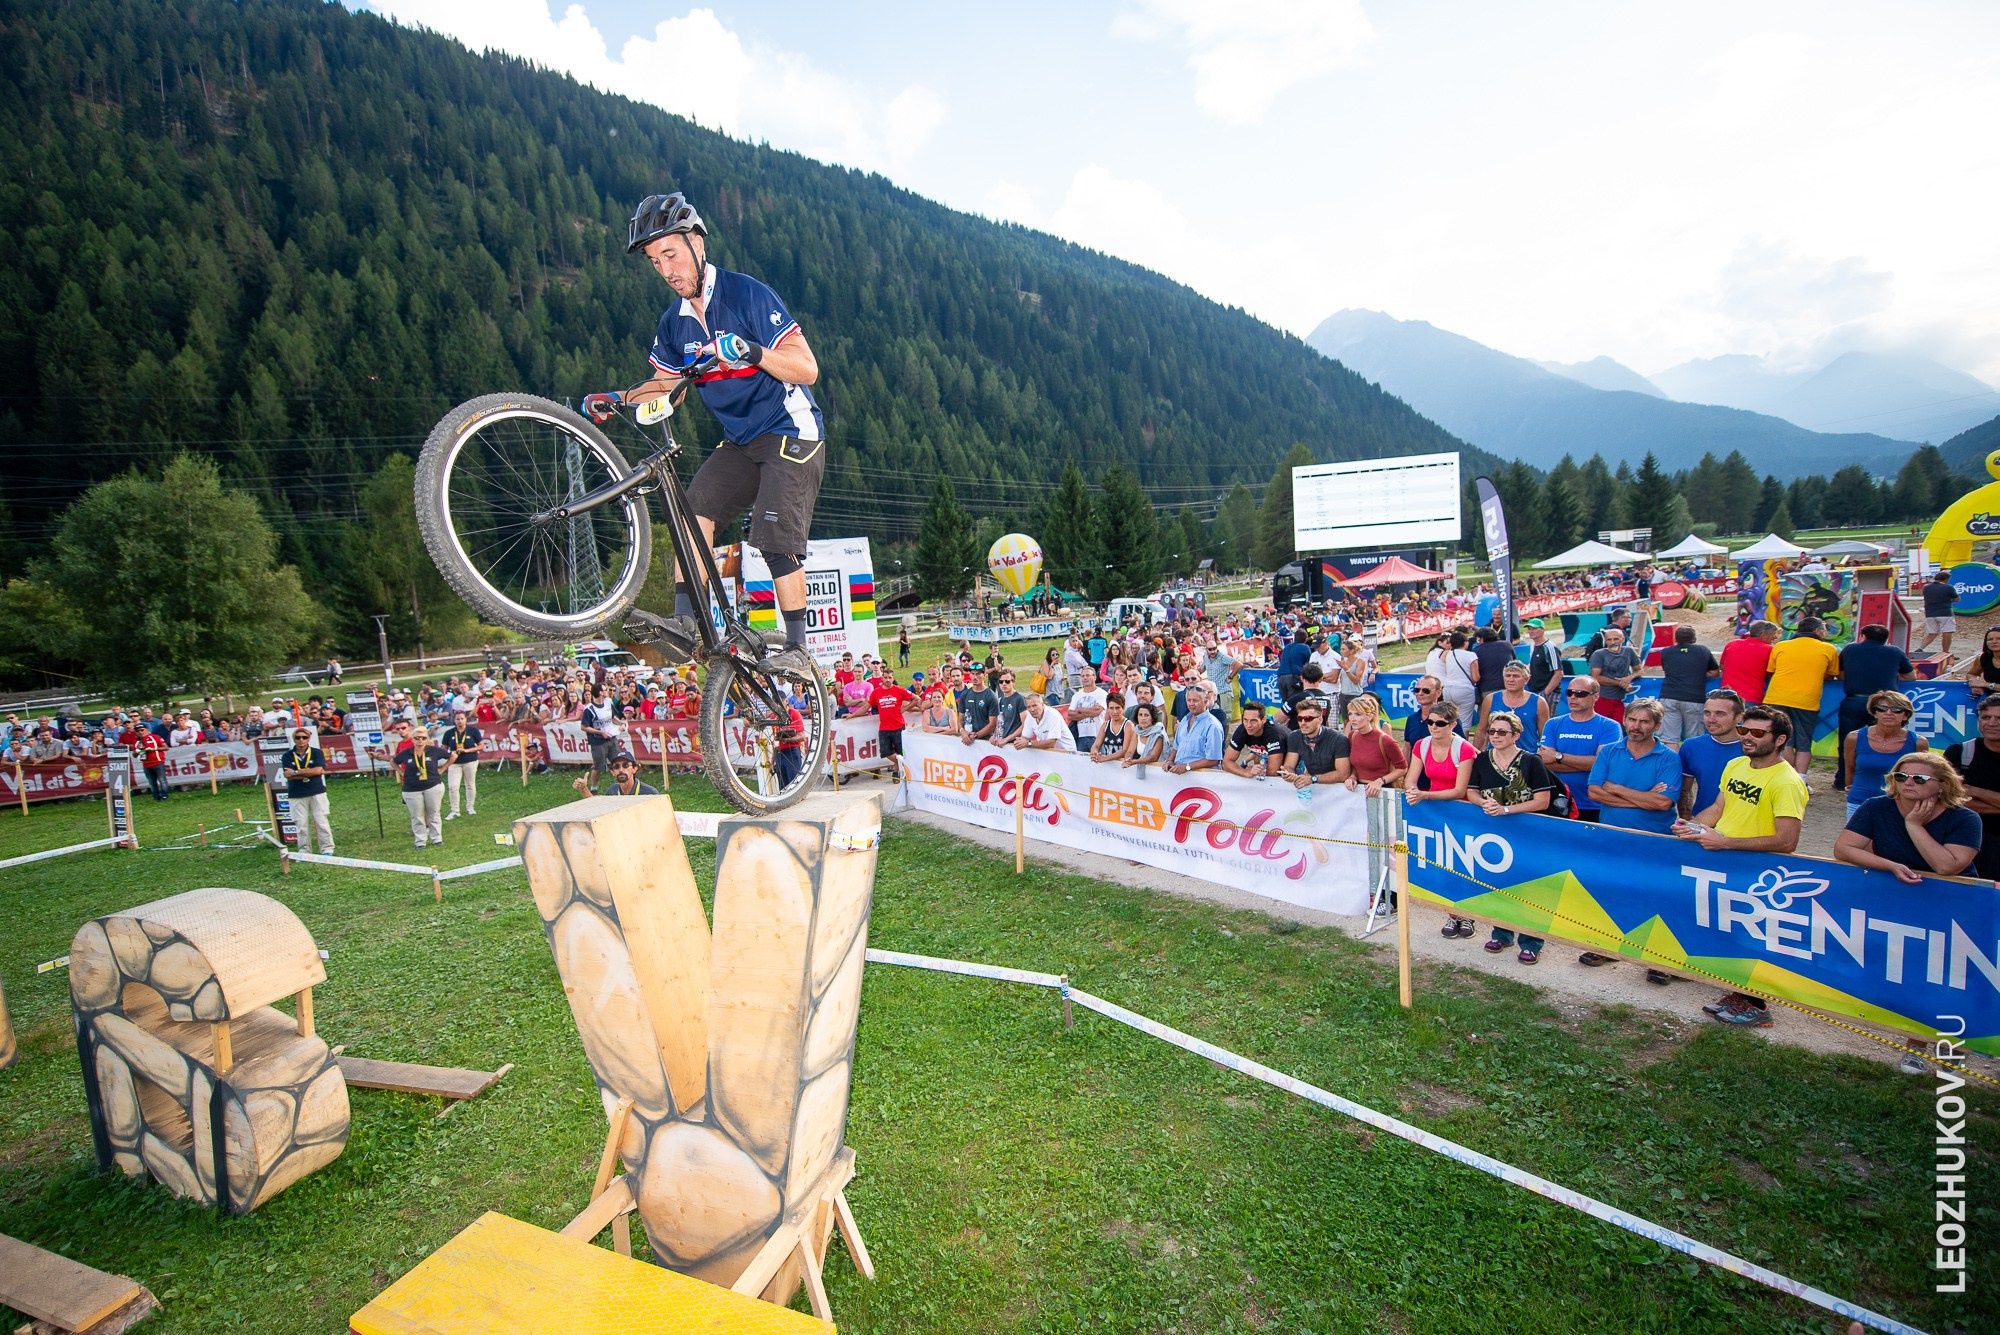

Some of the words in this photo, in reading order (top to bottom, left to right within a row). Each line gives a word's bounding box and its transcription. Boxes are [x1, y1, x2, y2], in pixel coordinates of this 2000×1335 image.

[648, 400, 658, 414] 10
[1350, 556, 1378, 565] WATCH
[806, 582, 837, 597] ORLD
[1954, 582, 1994, 594] ENTINO
[806, 598, 837, 606] PIONSHIPS
[806, 607, 839, 628] 016
[823, 633, 847, 643] TRIALS
[1000, 626, 1024, 638] PEJO
[1030, 623, 1054, 635] PEJO
[1252, 678, 1282, 704] TRE
[858, 738, 877, 759] di
[109, 763, 129, 771] START
[164, 759, 179, 777] al
[181, 761, 196, 776] di
[195, 752, 249, 774] Sole
[264, 755, 283, 764] FINIS
[0, 771, 44, 795] Val
[46, 775, 65, 789] di
[113, 775, 124, 793] 4
[926, 761, 967, 789] IPER
[977, 755, 1049, 810] Poli
[1726, 778, 1762, 802] HOKA
[924, 792, 983, 812] IPERCONVENIENZA
[985, 806, 1007, 816] TUTTI
[1093, 791, 1156, 827] IPER
[1169, 787, 1290, 860] Poli
[1091, 827, 1179, 854] IPERCONVENIENZA
[1184, 848, 1214, 861] TUTTI
[1229, 860, 1279, 876] GIORNI
